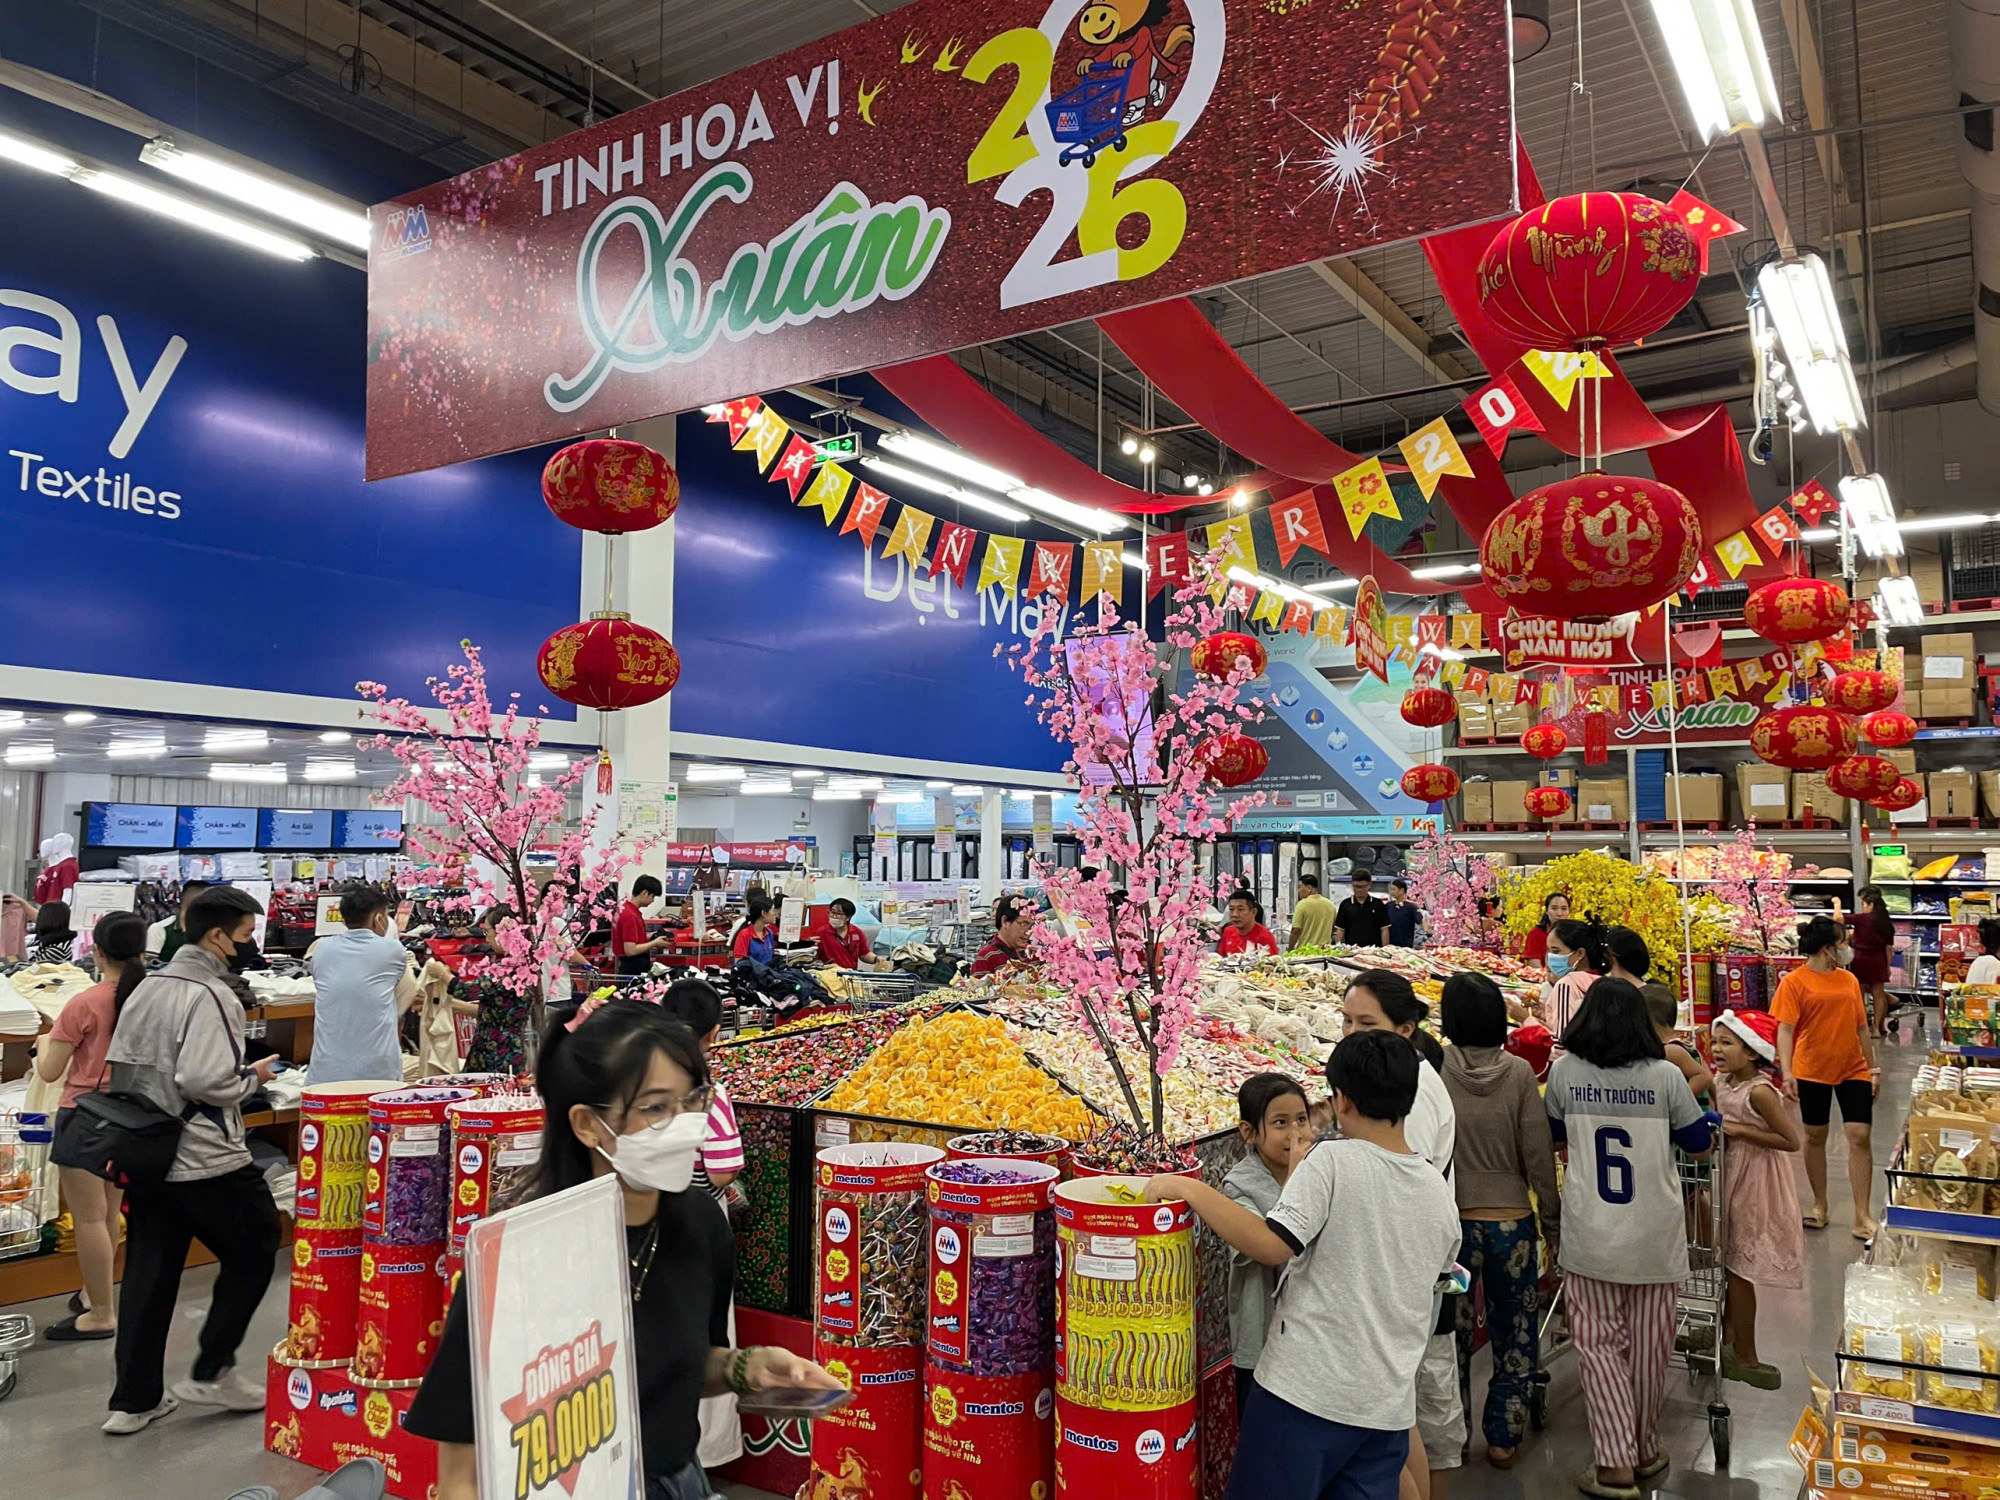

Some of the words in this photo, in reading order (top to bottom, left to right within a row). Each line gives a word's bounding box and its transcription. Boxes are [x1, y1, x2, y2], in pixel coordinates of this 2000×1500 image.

[535, 137, 644, 217] TINH
[659, 103, 774, 178] HOA
[787, 59, 841, 136] VỊ
[993, 120, 1187, 309] 26
[544, 161, 951, 413] Xuân
[8, 449, 182, 519] Textiles
[1507, 617, 1558, 641] CHÚC
[1609, 669, 1651, 687] TINH
[1394, 817, 1404, 831] 7
[1569, 1083, 1602, 1103] THIÊN
[1604, 1085, 1656, 1106] TRƯỜNG
[460, 1118, 493, 1128] mentos
[1594, 1124, 1636, 1205] 6
[835, 1173, 876, 1186] mentos
[940, 1190, 981, 1206] mentos
[379, 1262, 426, 1274] mentos
[821, 1315, 854, 1329] mentos
[573, 1326, 601, 1378] GIÁ
[930, 1338, 960, 1357] mentos
[860, 1368, 916, 1386] mentos
[934, 1393, 954, 1406] Chupa
[855, 1406, 871, 1420] Tết
[933, 1402, 953, 1419] Chups
[965, 1401, 1024, 1416] mentos
[858, 1419, 877, 1432] Nhà
[511, 1370, 617, 1500] 79.000Đ
[1065, 1428, 1119, 1453] mentos
[960, 1439, 975, 1452] Tết
[1140, 1436, 1162, 1452] MM
[350, 1443, 369, 1455] ngào
[385, 1452, 397, 1468] Tết
[963, 1452, 982, 1465] Nhà
